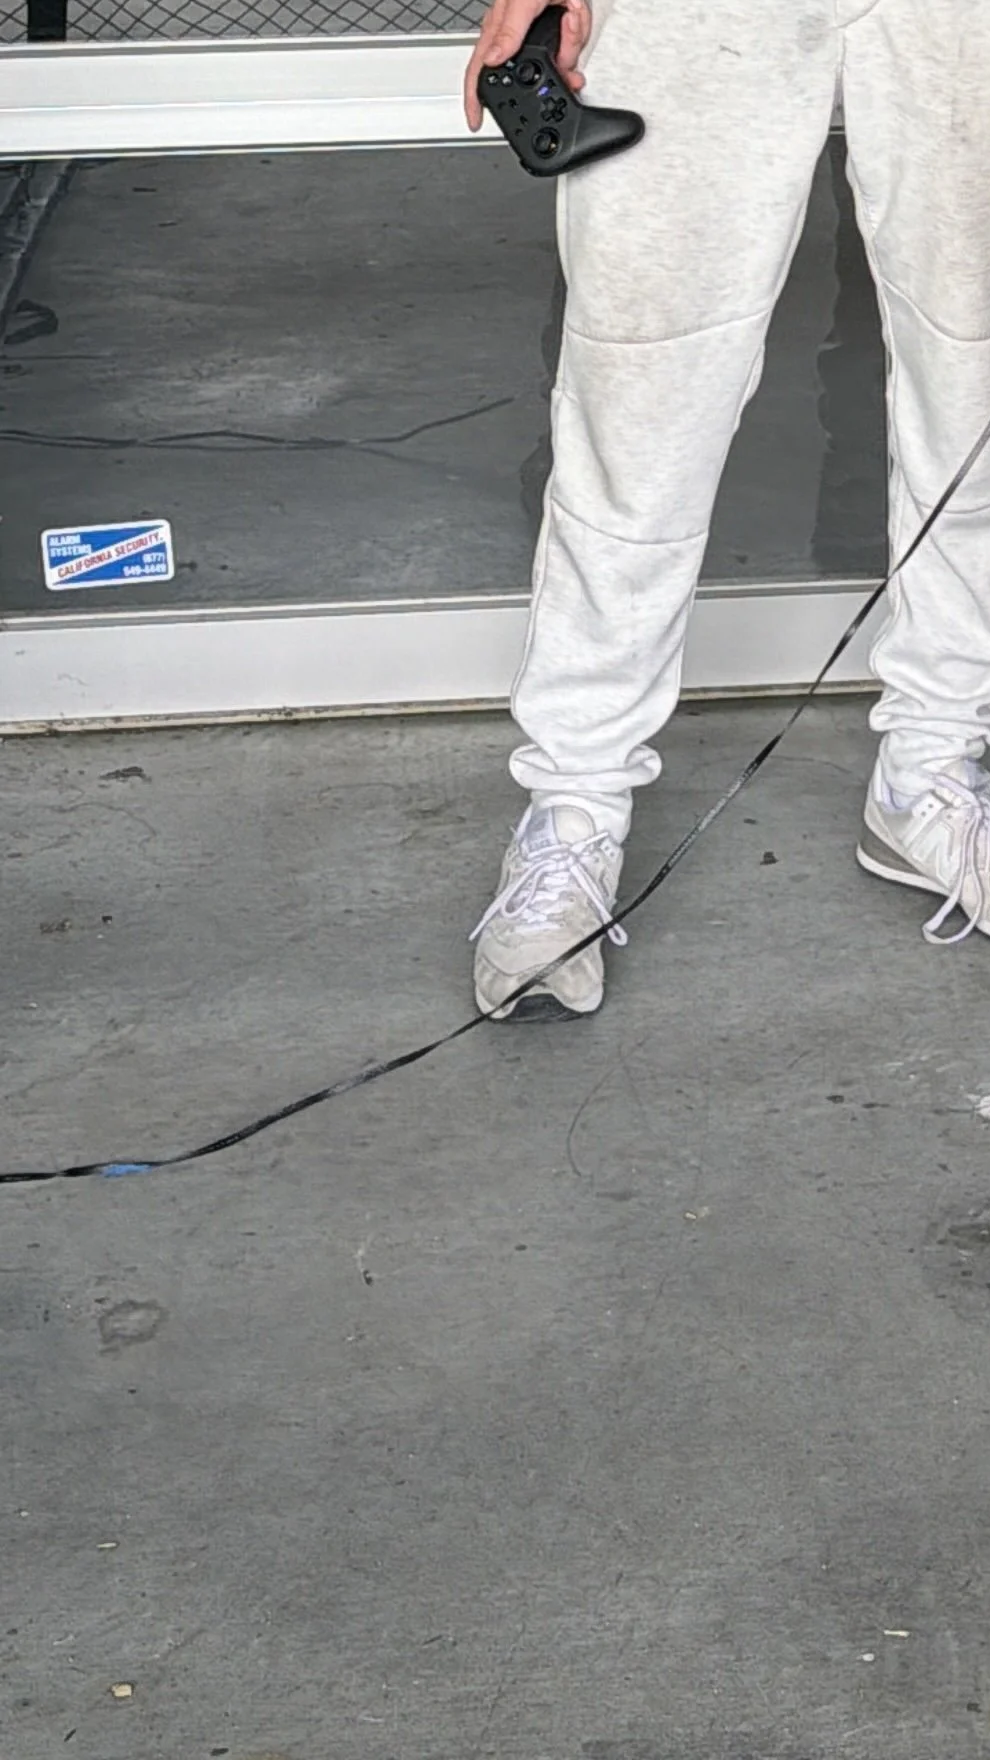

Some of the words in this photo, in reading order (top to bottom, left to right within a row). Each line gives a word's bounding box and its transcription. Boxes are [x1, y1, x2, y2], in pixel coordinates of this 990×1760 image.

[49, 534, 81, 546] ALARM
[49, 544, 92, 557] SYSTEMS
[57, 551, 113, 578] CALIFORNIA
